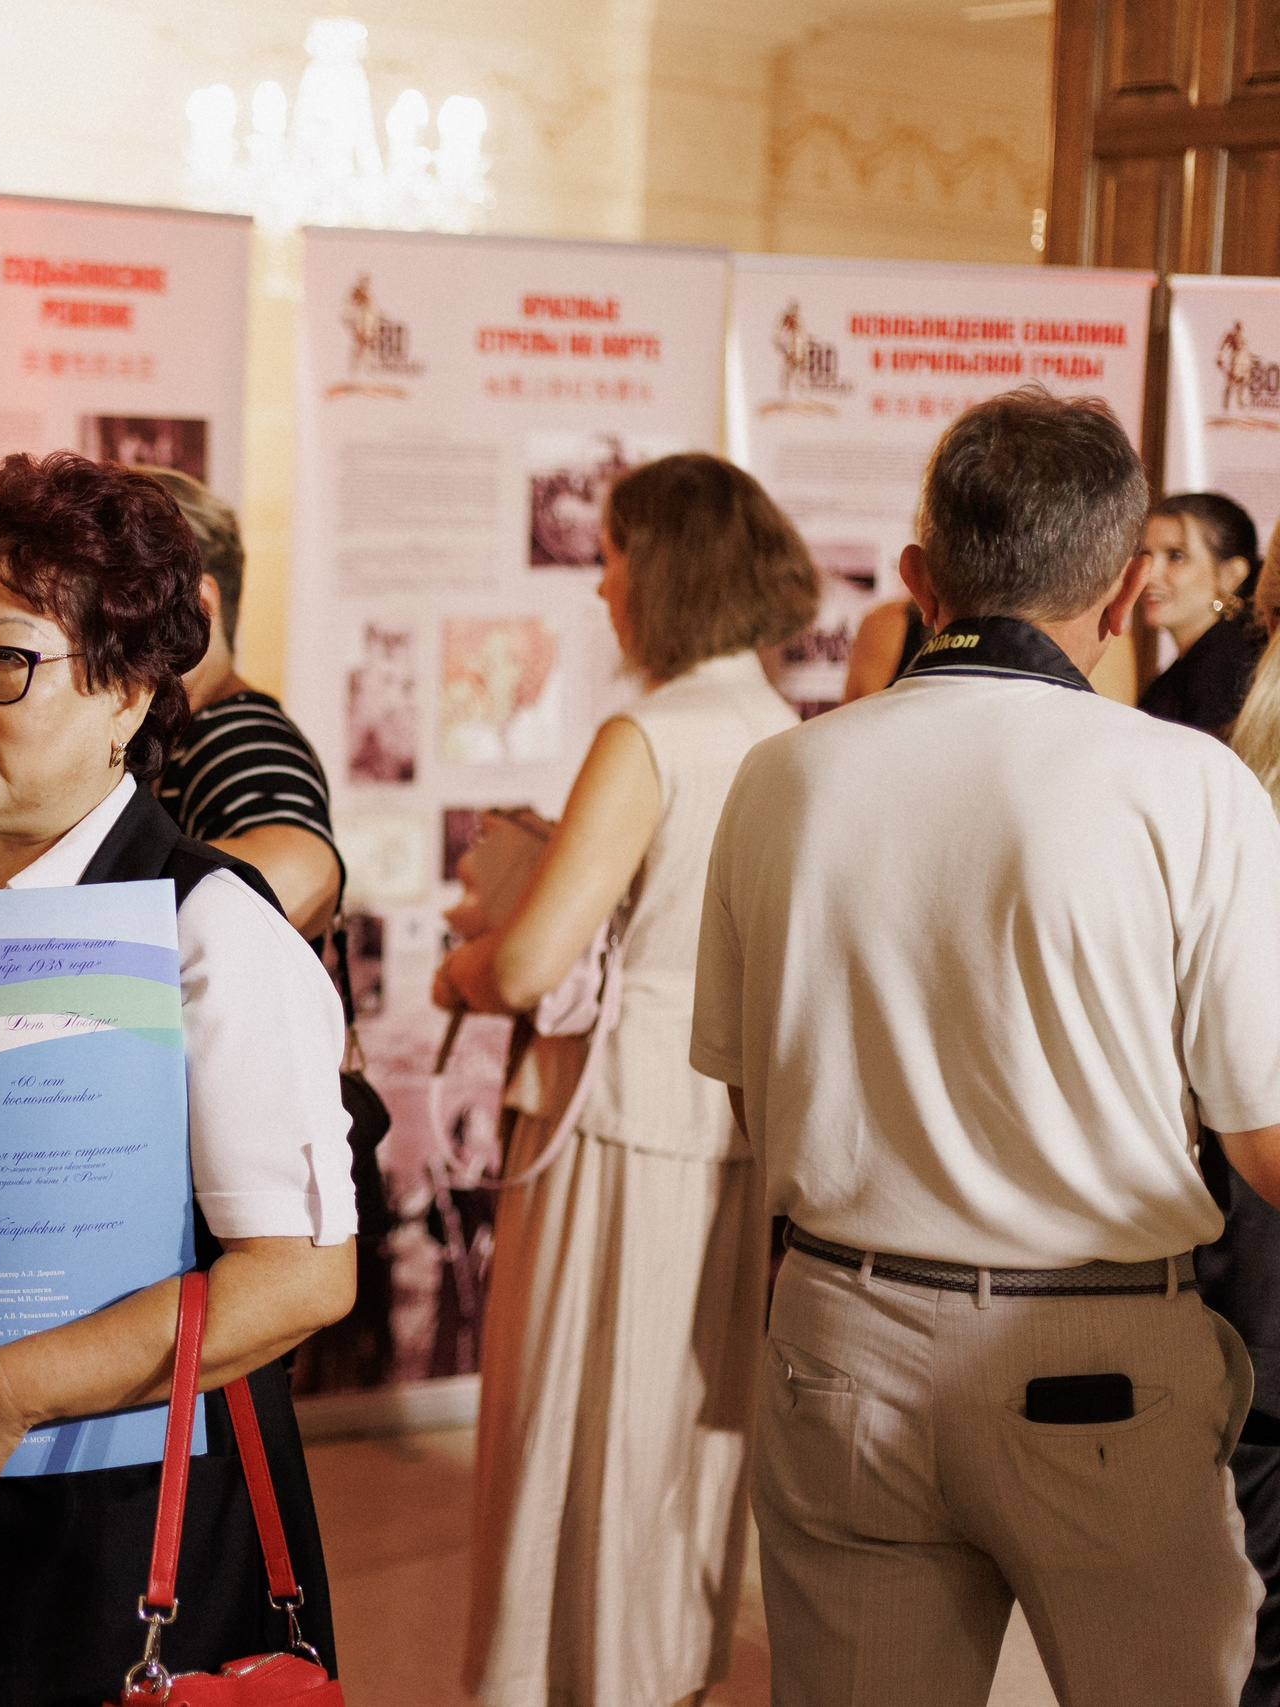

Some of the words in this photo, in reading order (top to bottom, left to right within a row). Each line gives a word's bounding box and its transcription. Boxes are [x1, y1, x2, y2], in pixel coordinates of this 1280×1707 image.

[921, 633, 980, 656] Nikon
[4, 937, 118, 959] дальневосточный
[28, 959, 65, 975] 1938
[69, 961, 102, 976] года»
[5, 1013, 44, 1031] День
[51, 1010, 119, 1033] Победы»
[11, 1075, 37, 1087] «60
[39, 1077, 65, 1087] лет
[2, 1088, 103, 1106] космонавтики»
[12, 1150, 71, 1165] прошлого
[75, 1142, 148, 1162] страницы»
[72, 1220, 124, 1238] процесс»
